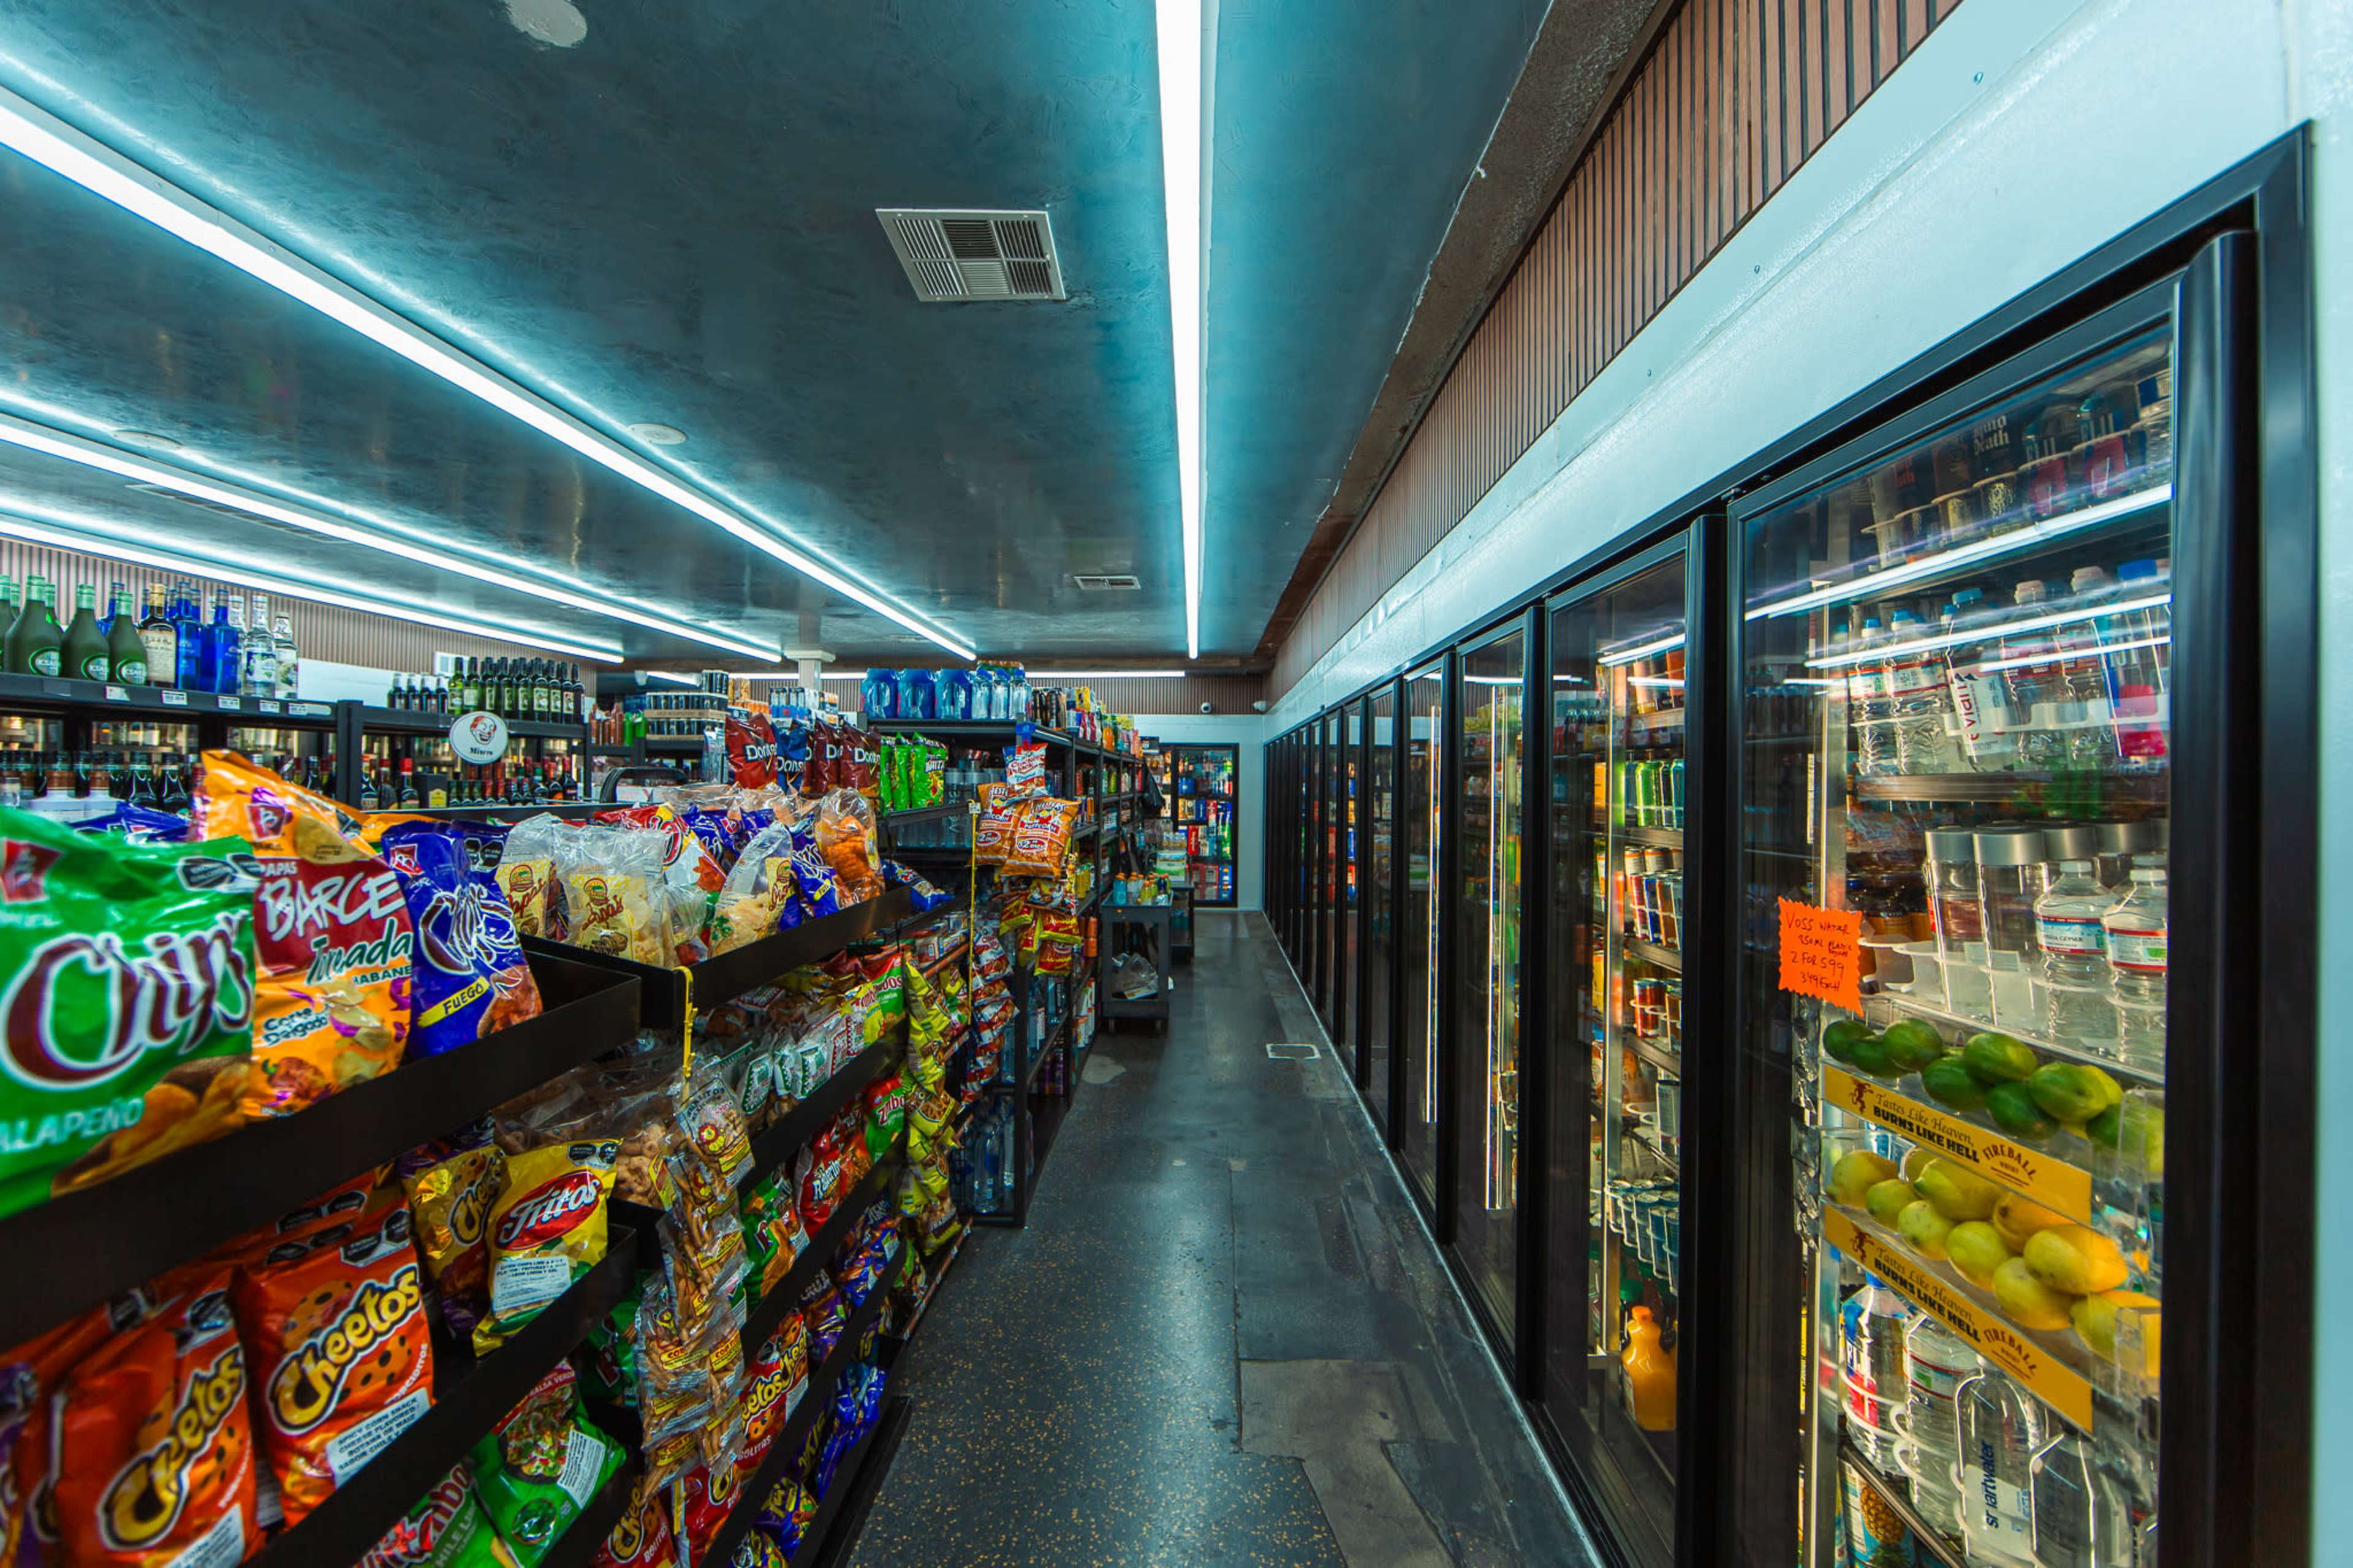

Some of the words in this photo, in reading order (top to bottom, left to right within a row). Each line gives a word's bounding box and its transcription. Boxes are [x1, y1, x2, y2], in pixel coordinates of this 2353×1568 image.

[1786, 912, 1814, 931] VOSS
[1790, 951, 1798, 964] 2
[1802, 951, 1818, 966] FOR
[1821, 957, 1845, 979] 599
[442, 983, 485, 1016] FUEGO
[1873, 1105, 1915, 1134] BURNS
[1916, 1124, 1945, 1147] LIKE
[1946, 1136, 1980, 1164] HELL
[1875, 1093, 1905, 1116] Tastes
[1908, 1107, 1930, 1126] Like
[1931, 1118, 1975, 1147] Heaven,
[1982, 1142, 2037, 1180] FIREBALL
[498, 1178, 602, 1245] Fritos
[1876, 1247, 1905, 1274] Tastes
[1909, 1270, 1930, 1289] Like
[1873, 1257, 1915, 1295] BURNS
[1917, 1288, 1946, 1319] LIKE
[1947, 1309, 1982, 1344] HELL
[268, 1264, 423, 1434] Cheetos
[1982, 1327, 2038, 1376] FIREBALL
